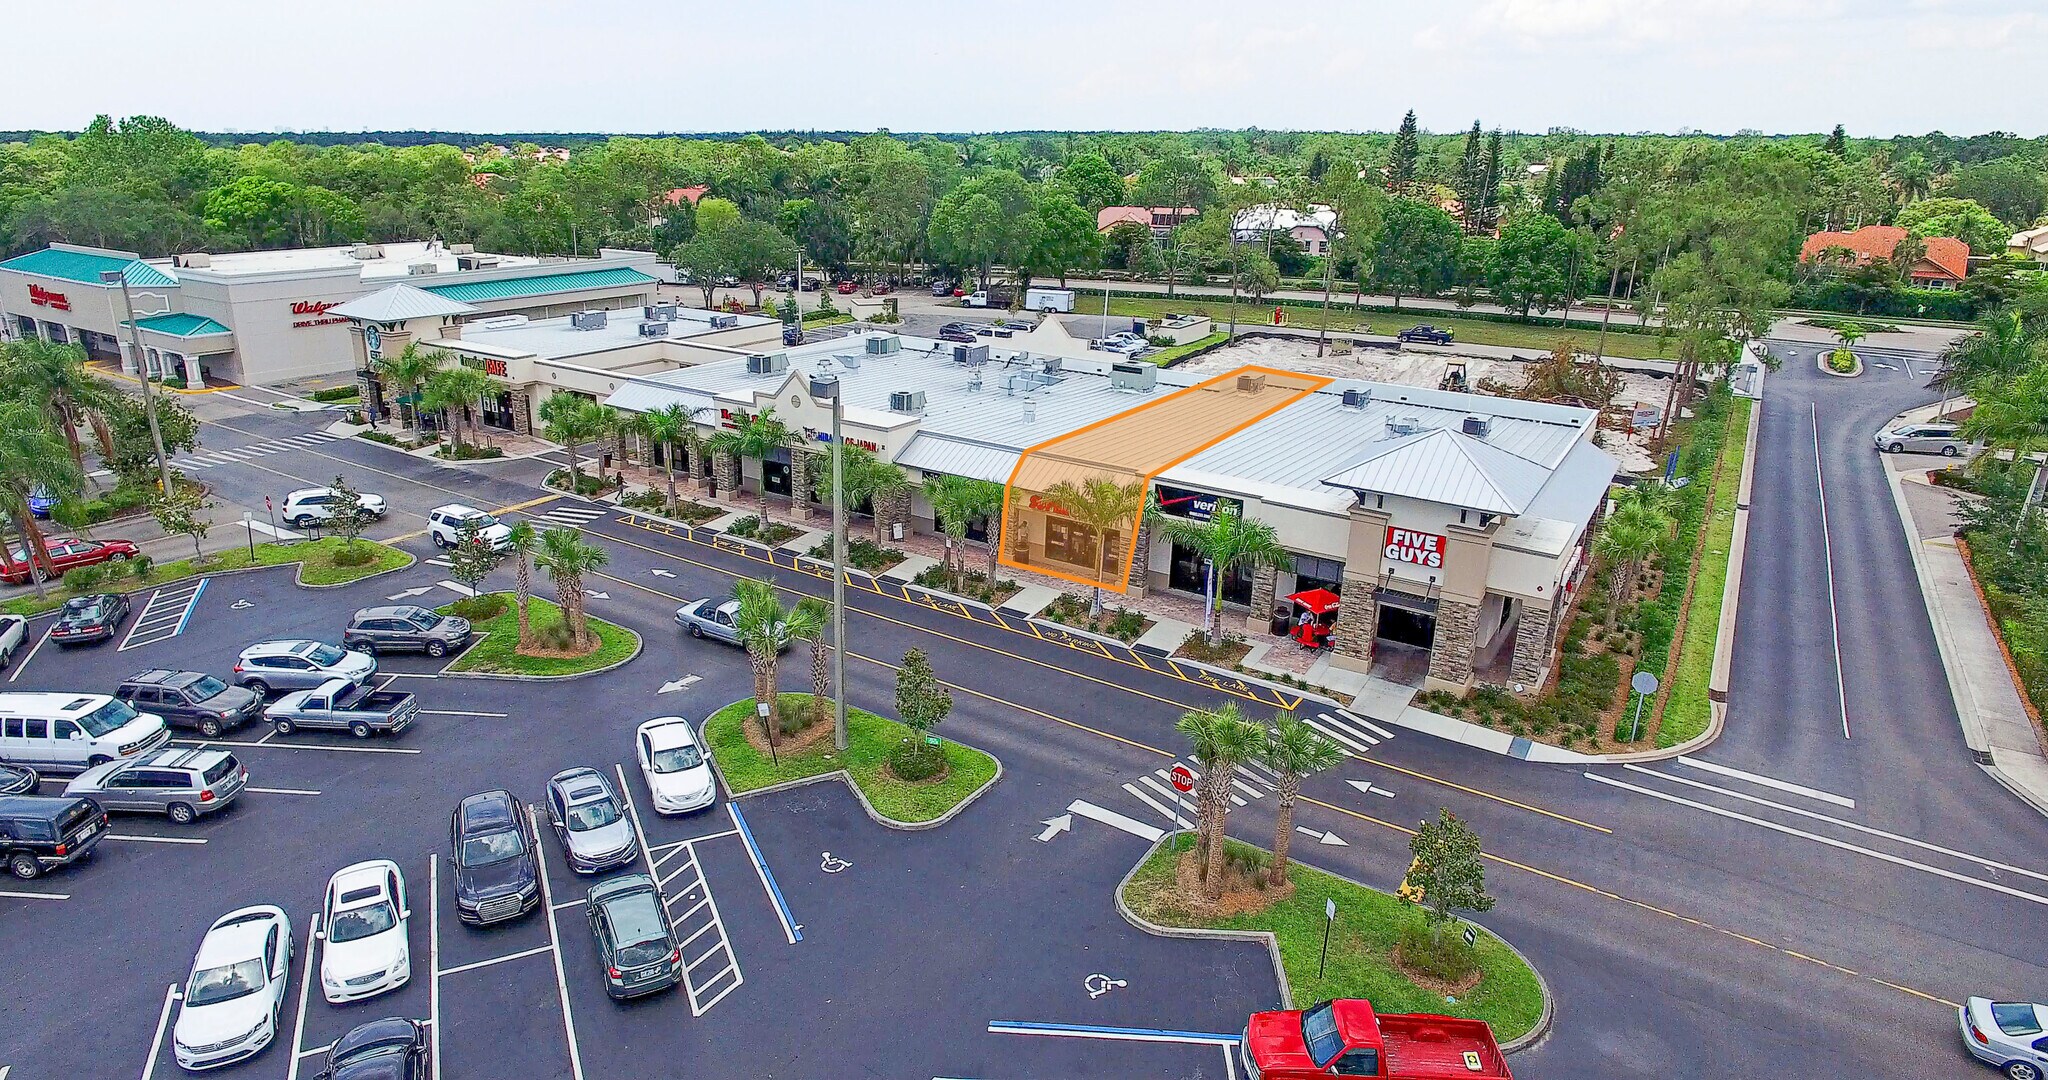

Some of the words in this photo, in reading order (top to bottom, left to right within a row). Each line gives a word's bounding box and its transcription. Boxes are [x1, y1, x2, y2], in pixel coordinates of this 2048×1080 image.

[1392, 529, 1438, 551] FIVE
[1385, 544, 1441, 567] GUYS
[1060, 635, 1097, 649] PARKING
[1171, 771, 1193, 787] STOP
